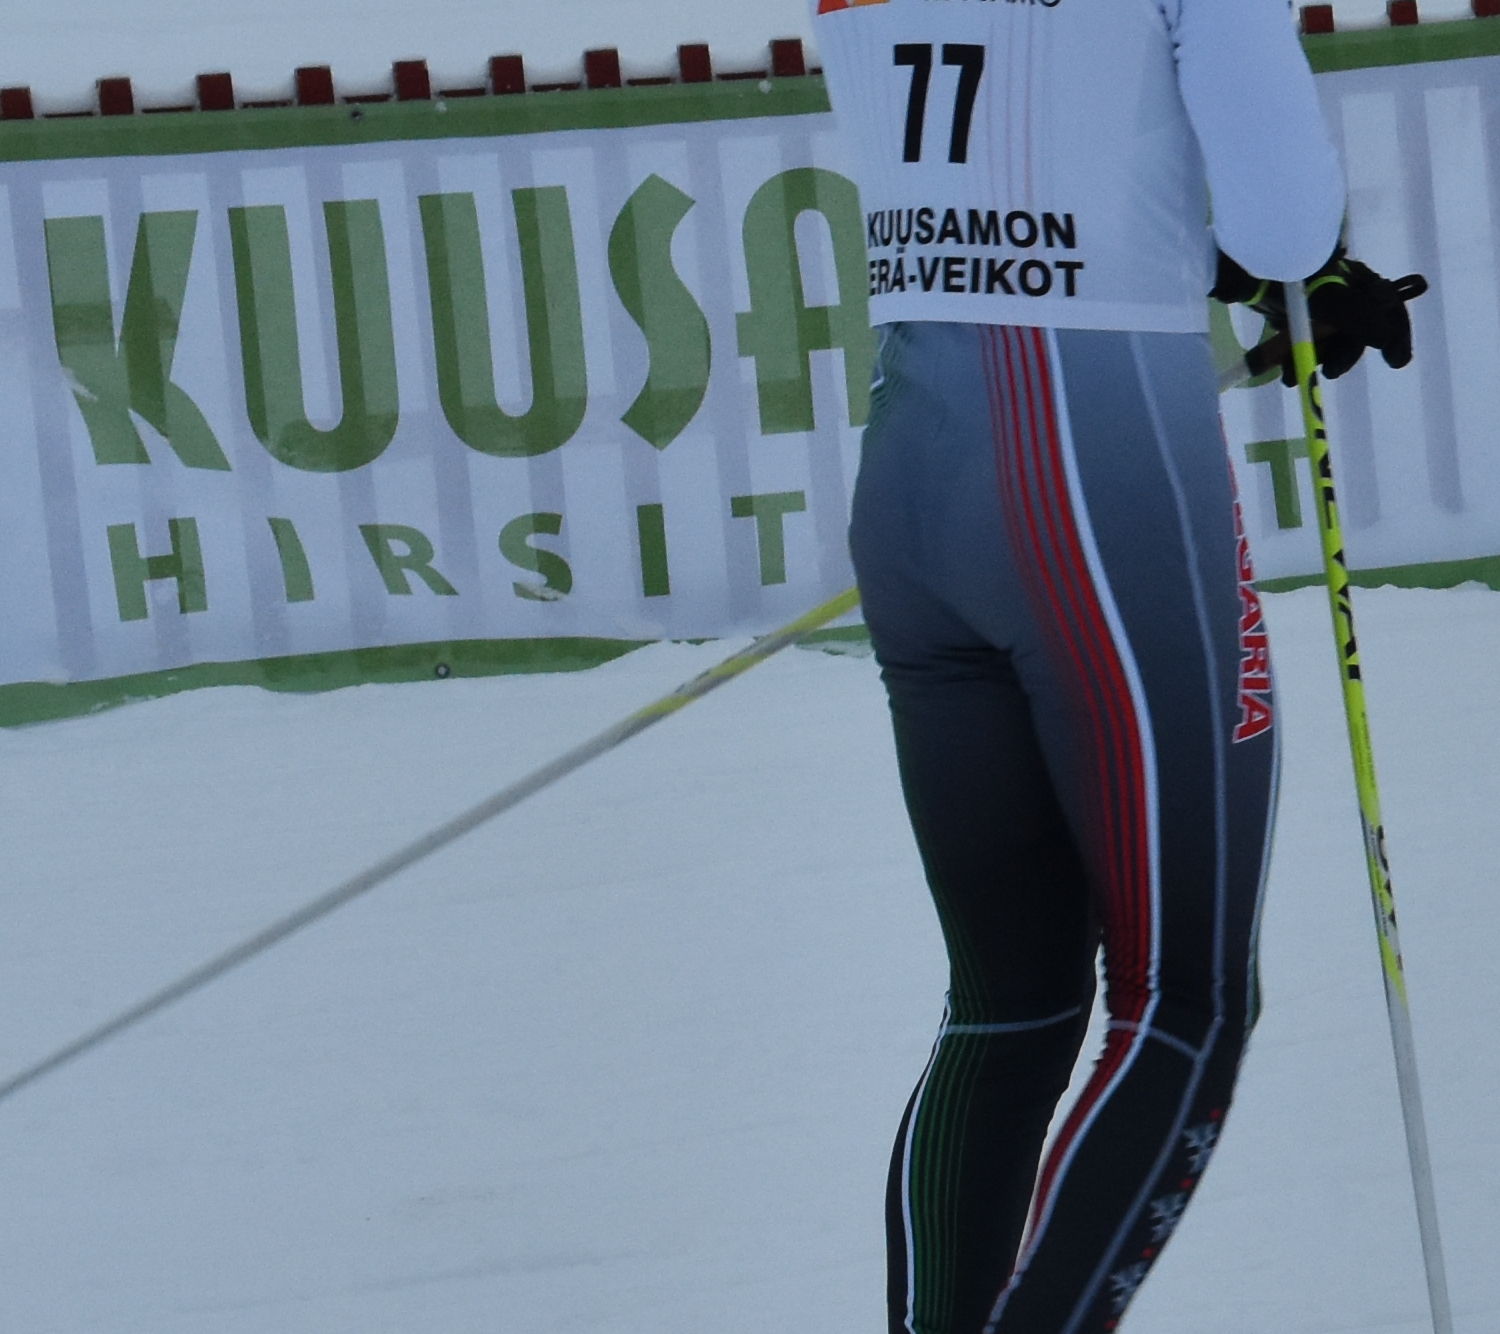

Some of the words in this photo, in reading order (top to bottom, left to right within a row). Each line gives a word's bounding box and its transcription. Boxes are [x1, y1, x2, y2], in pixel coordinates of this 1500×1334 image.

[893, 42, 986, 165] 77
[867, 207, 1077, 249] KUUSAMON
[868, 247, 1084, 297] ERÄ-VEIKOT
